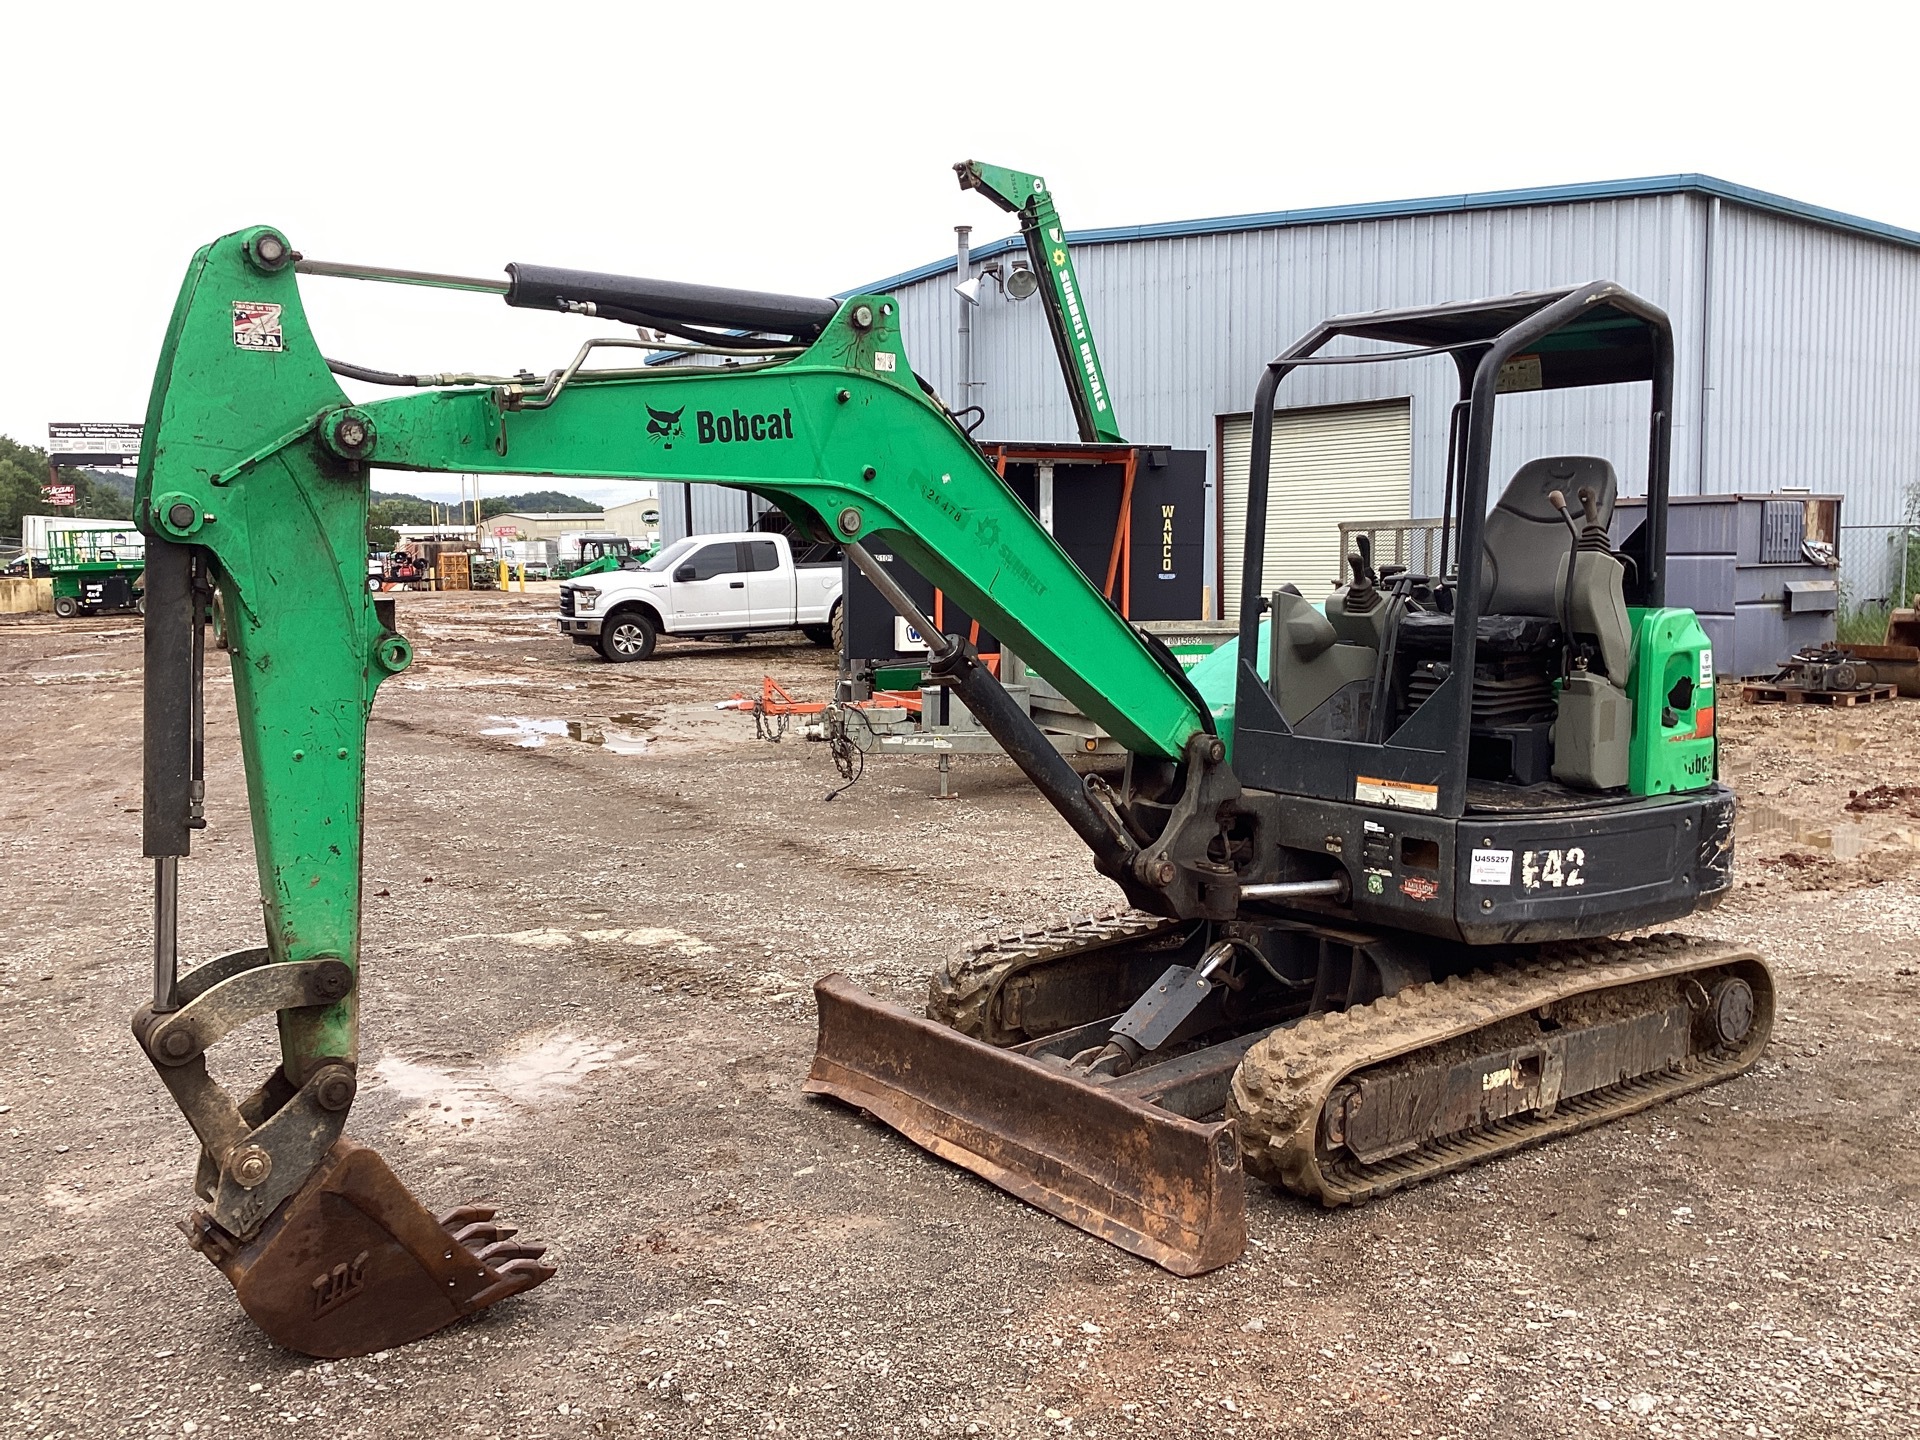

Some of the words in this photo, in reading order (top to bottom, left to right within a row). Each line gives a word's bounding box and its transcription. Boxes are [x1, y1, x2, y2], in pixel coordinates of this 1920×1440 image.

[237, 333, 279, 346] USA
[1059, 269, 1086, 340] SUNBELT
[1080, 342, 1107, 412] RENTALS
[697, 408, 793, 444] Bobcat
[1162, 505, 1175, 571] WANCO
[1387, 781, 1412, 789] WARNING
[1474, 855, 1510, 863] U455257
[1522, 847, 1585, 889] E42
[1408, 881, 1434, 894] MILLION
